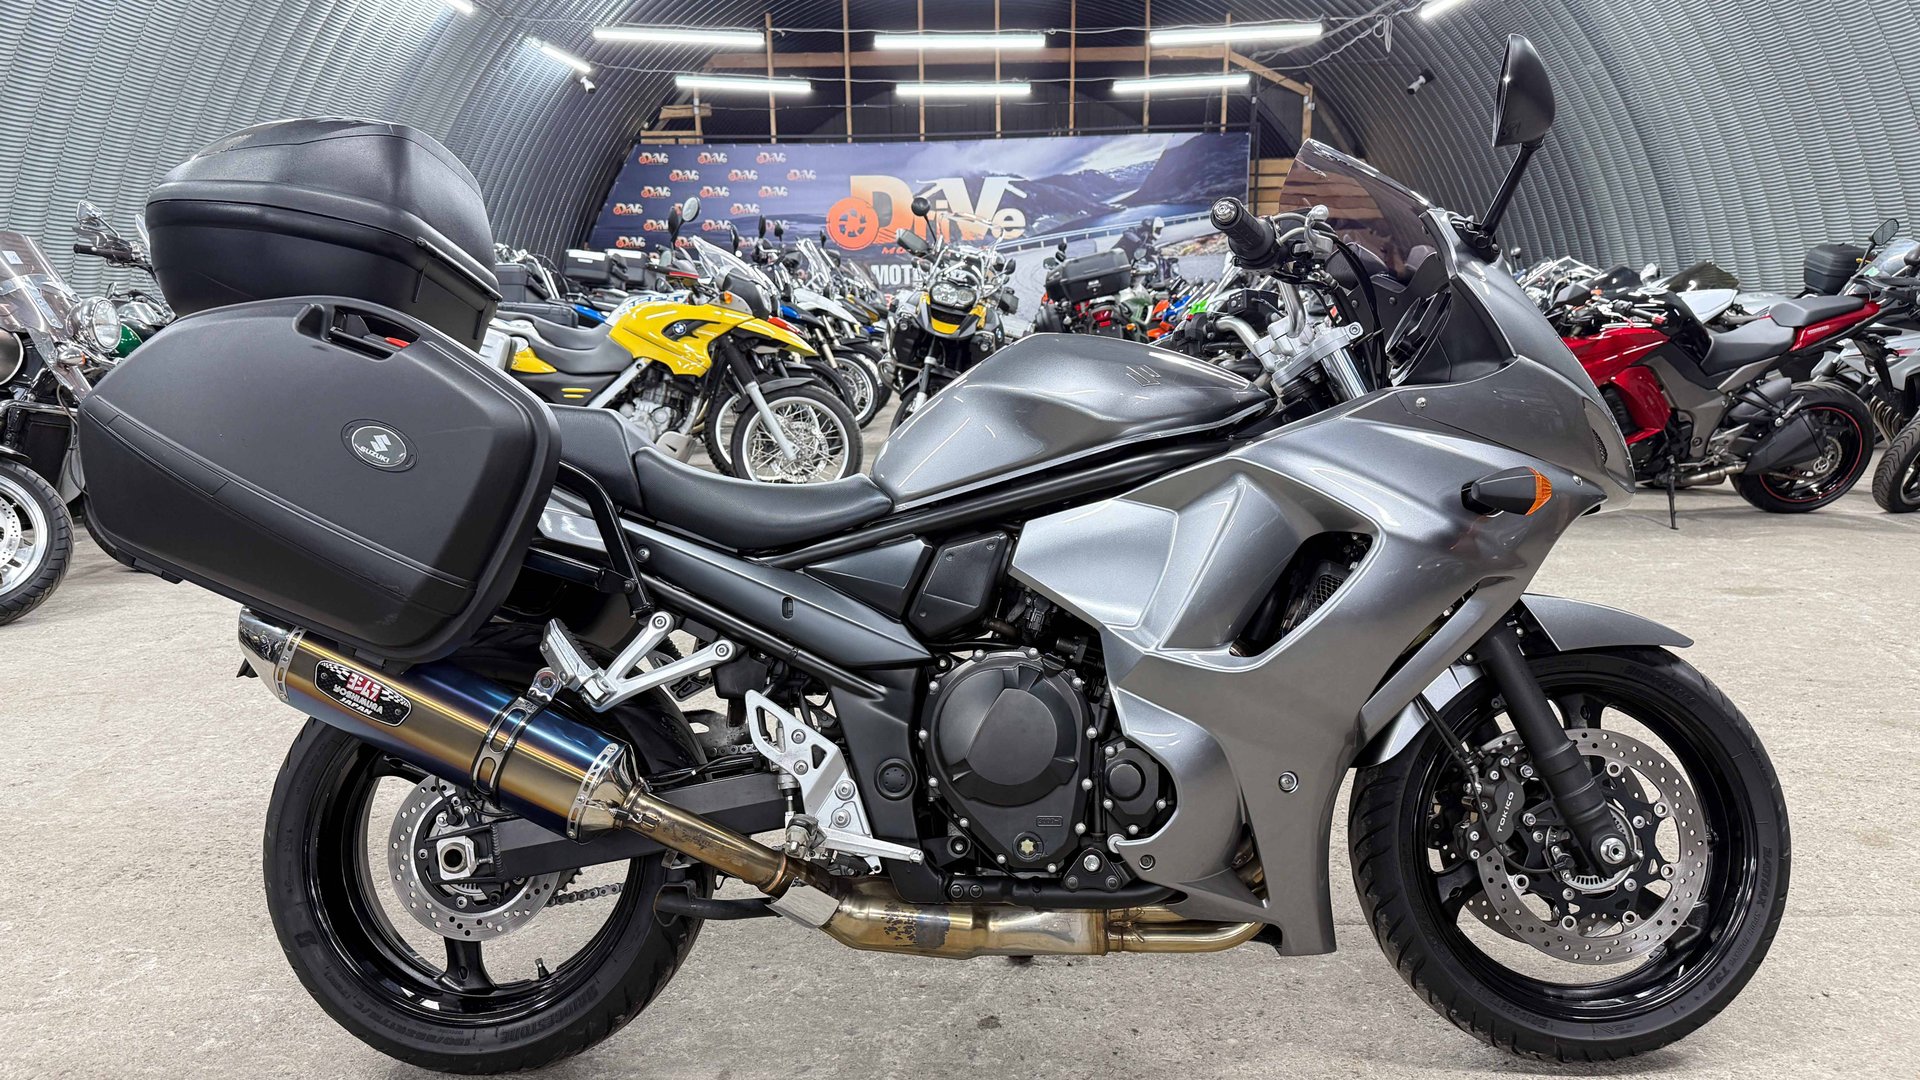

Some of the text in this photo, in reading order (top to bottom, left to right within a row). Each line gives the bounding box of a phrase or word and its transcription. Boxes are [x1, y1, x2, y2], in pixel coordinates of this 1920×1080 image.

[360, 445, 390, 463] SUZUKI
[333, 684, 383, 714] YOSHIMURA
[347, 673, 381, 701] ヨシムラ
[341, 697, 373, 715] JAPAN
[1497, 791, 1514, 832] TOKICO
